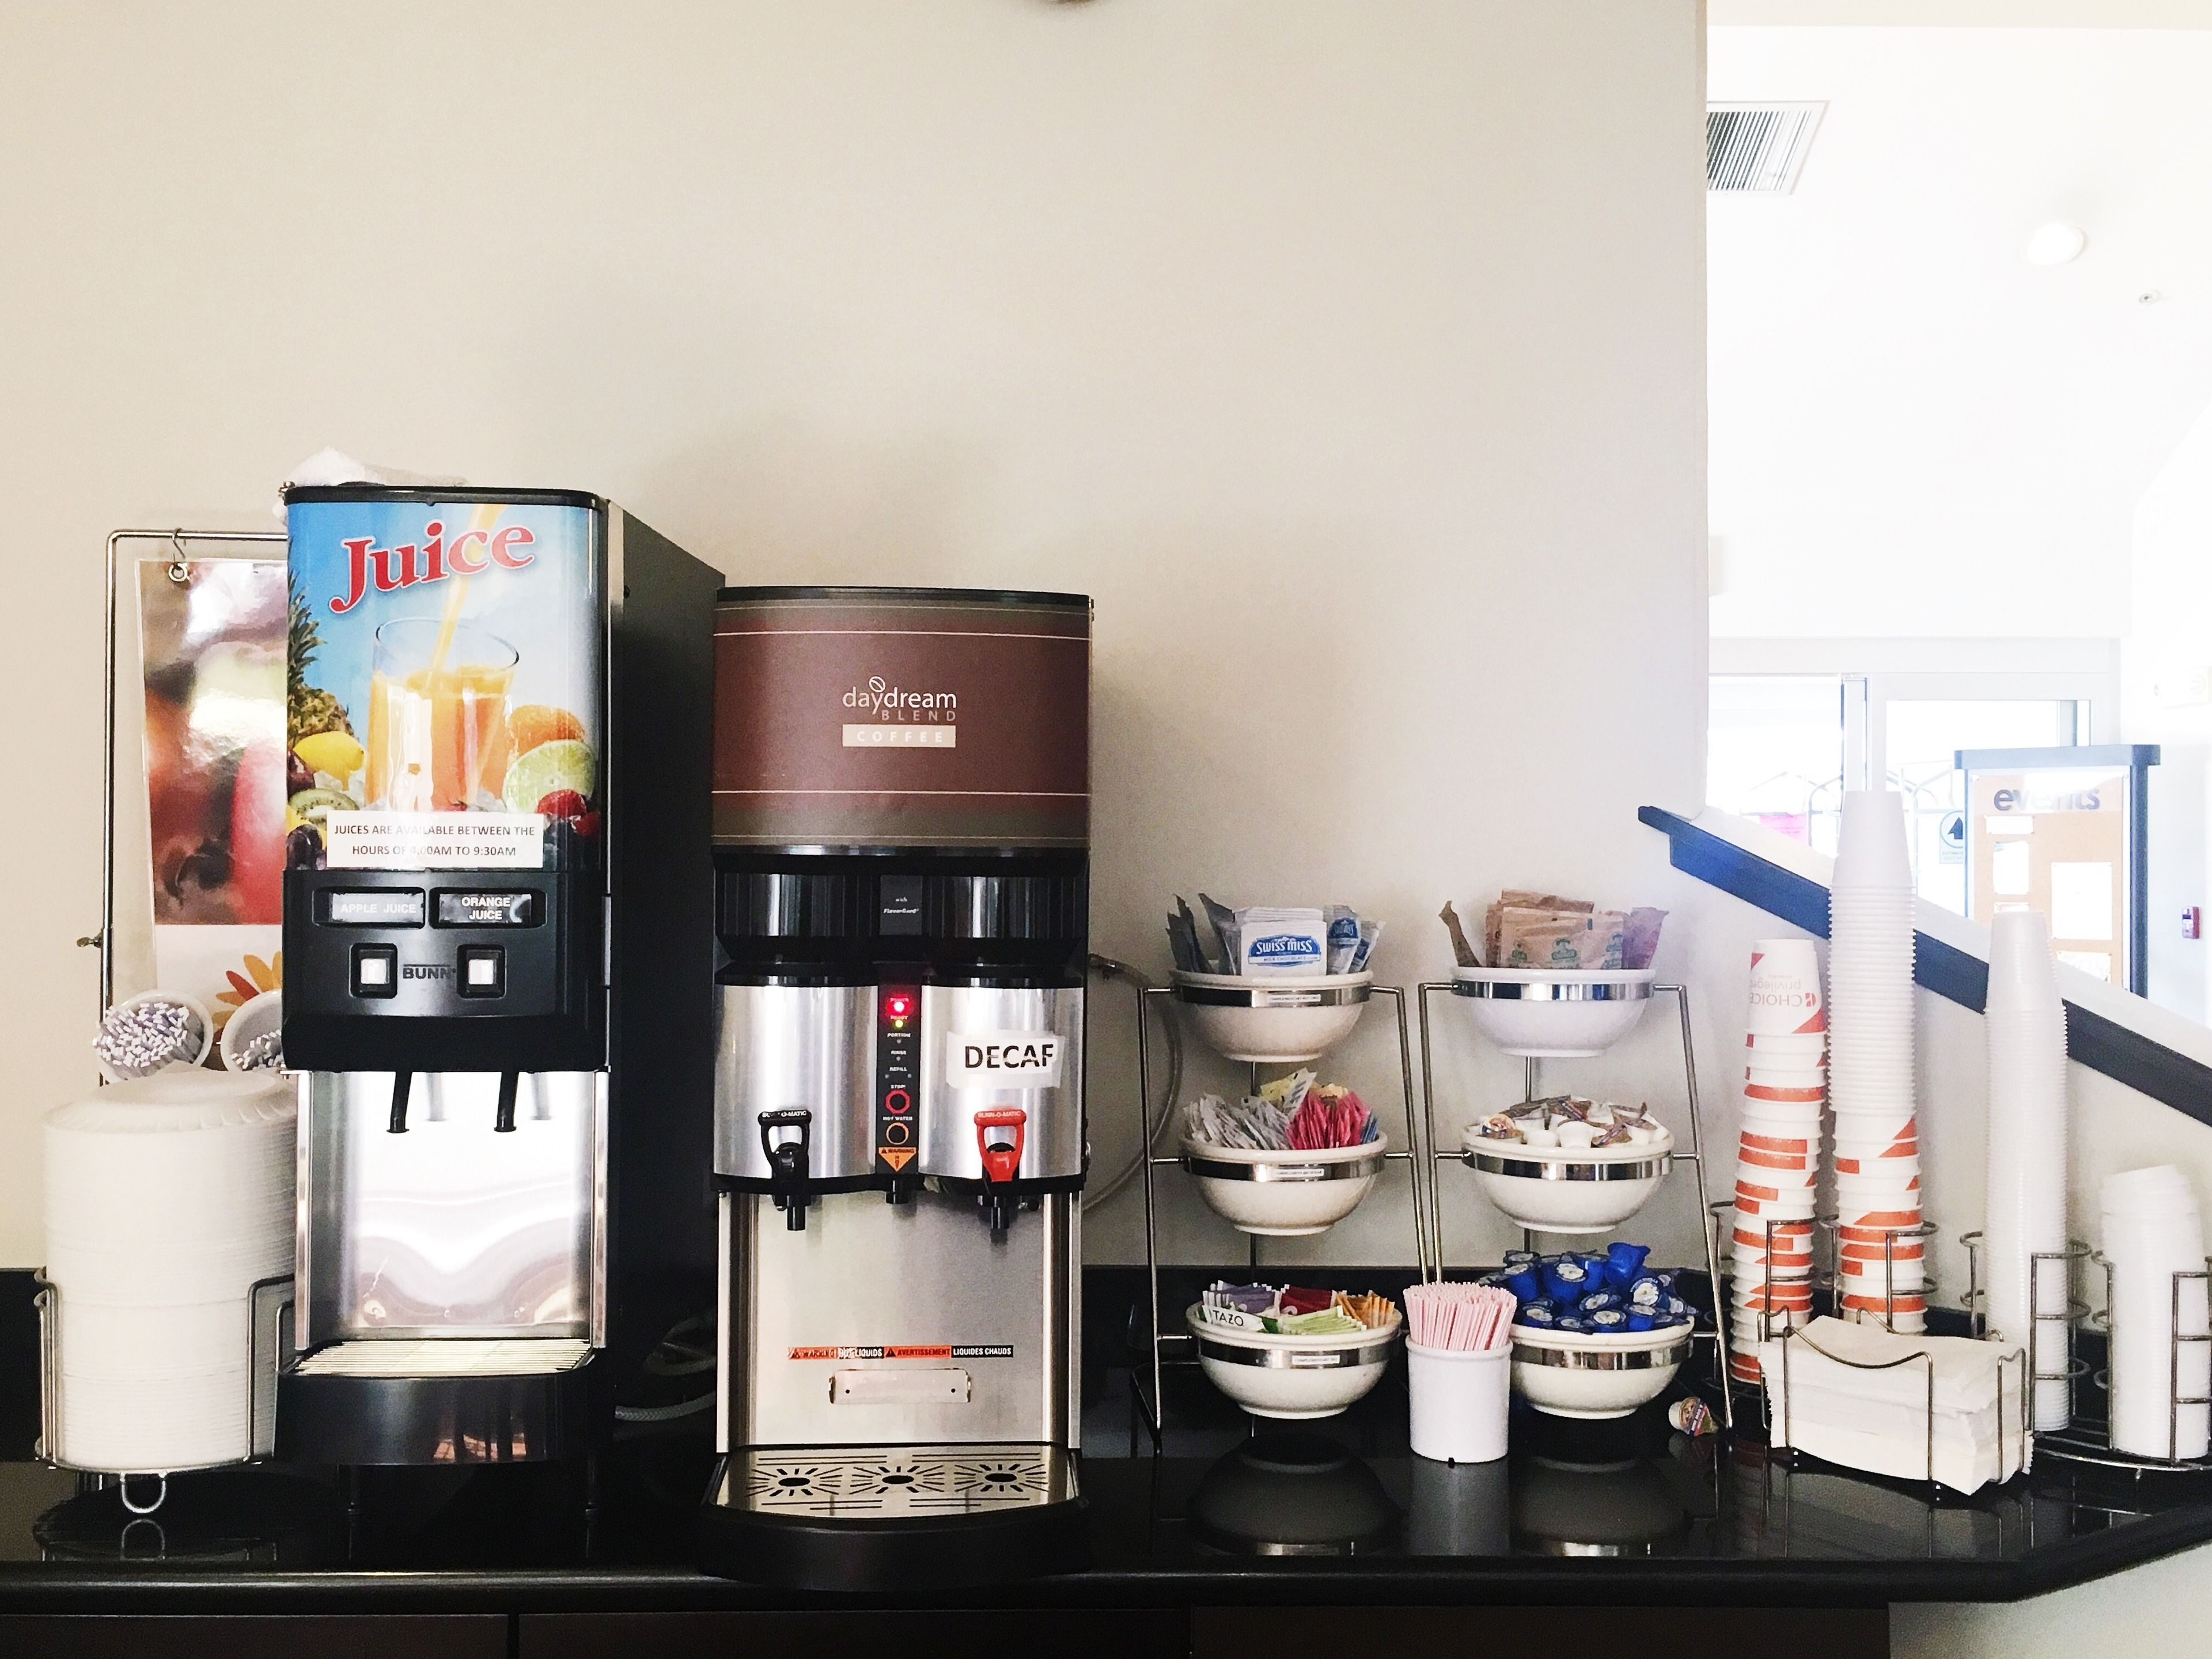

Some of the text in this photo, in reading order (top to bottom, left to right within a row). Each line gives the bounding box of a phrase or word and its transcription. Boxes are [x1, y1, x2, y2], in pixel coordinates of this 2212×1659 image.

[329, 519, 535, 613] Juice
[842, 685, 957, 715] daydream
[881, 710, 956, 721] BLEND
[857, 731, 943, 743] COFFEE
[1994, 788, 2100, 811] events
[335, 825, 535, 836] JUICES ARE AVAILABLE BETWEEN THE
[353, 846, 389, 855] HOURS
[393, 846, 406, 855] OF
[456, 847, 470, 855] TO
[474, 846, 516, 856] 9:30AM
[461, 896, 511, 907] ORANGE
[340, 903, 416, 914] APPLE JUICE
[468, 910, 503, 921] JUICE
[403, 967, 452, 980] BUNN
[1749, 992, 1802, 1007] CHOICE
[965, 1044, 1054, 1069] DECAF
[855, 1347, 883, 1358] LIQUIDS
[897, 1347, 1012, 1357] AVERTISSEMENT LIQUIDES CHAUDS
